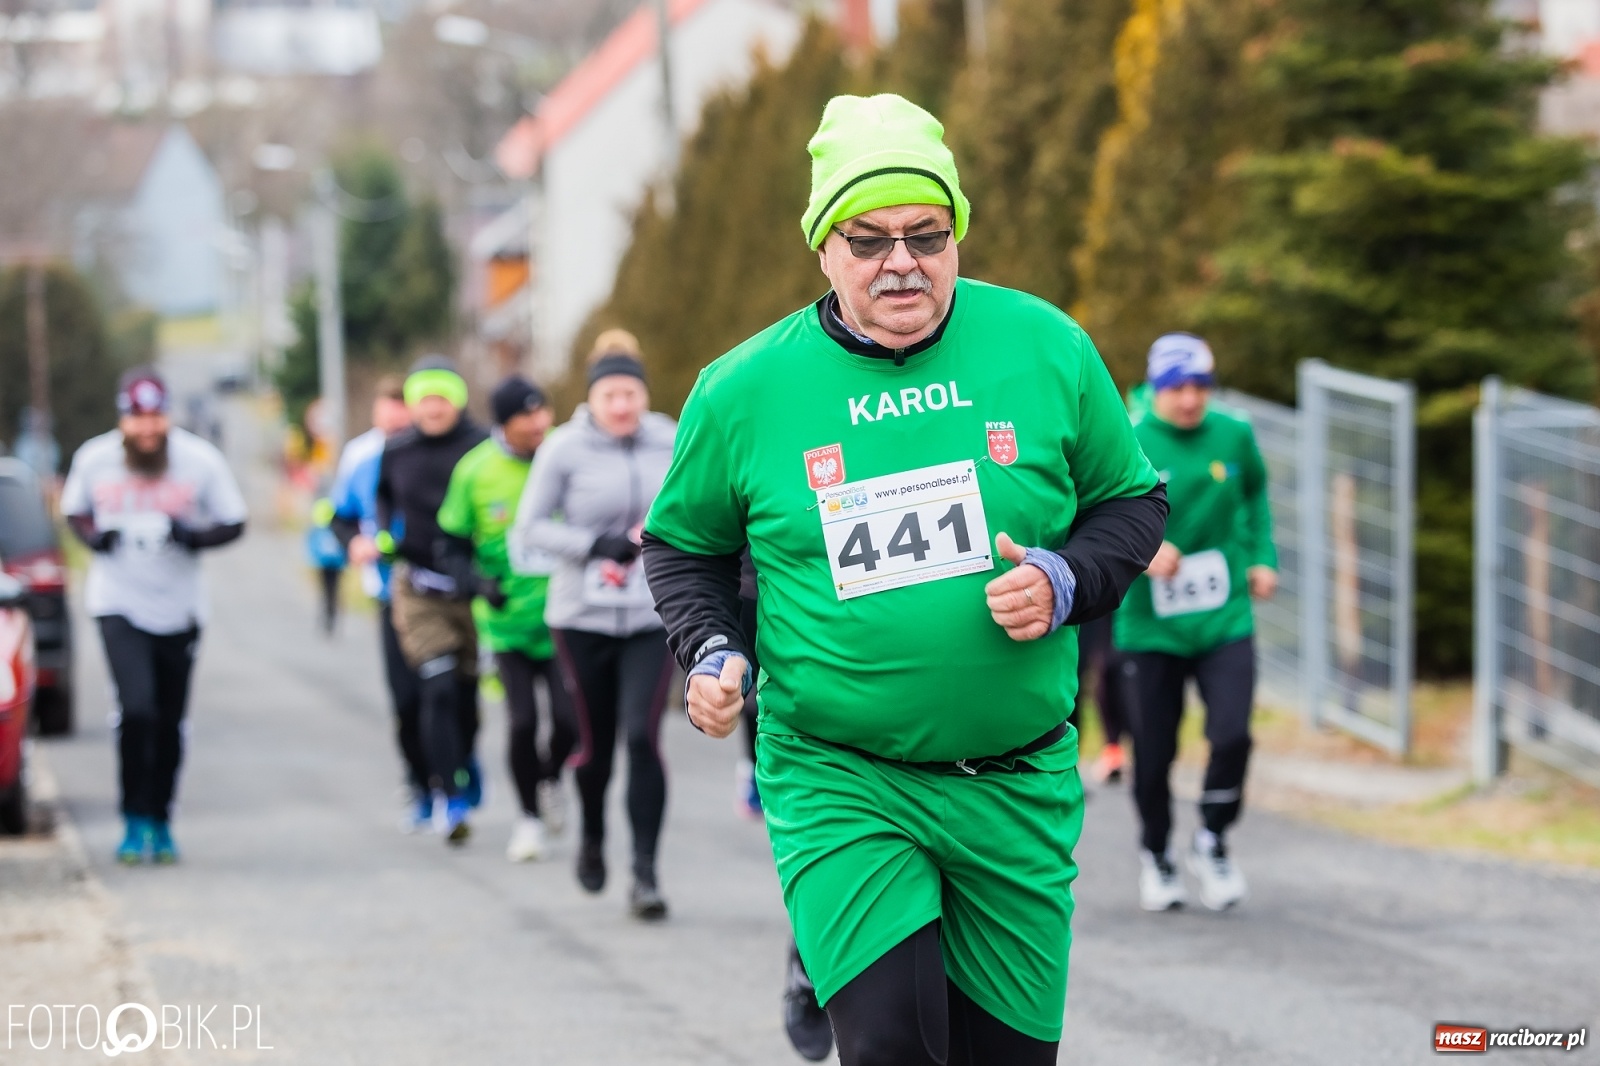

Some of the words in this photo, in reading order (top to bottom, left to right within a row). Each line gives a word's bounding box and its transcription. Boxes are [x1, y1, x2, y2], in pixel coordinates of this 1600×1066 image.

[847, 380, 973, 426] KAROL
[985, 420, 1015, 430] NYSA
[806, 446, 839, 460] POLAND
[825, 485, 867, 500] PersonalBest
[874, 473, 971, 499] www.personalbest.pl
[837, 502, 972, 573] 441
